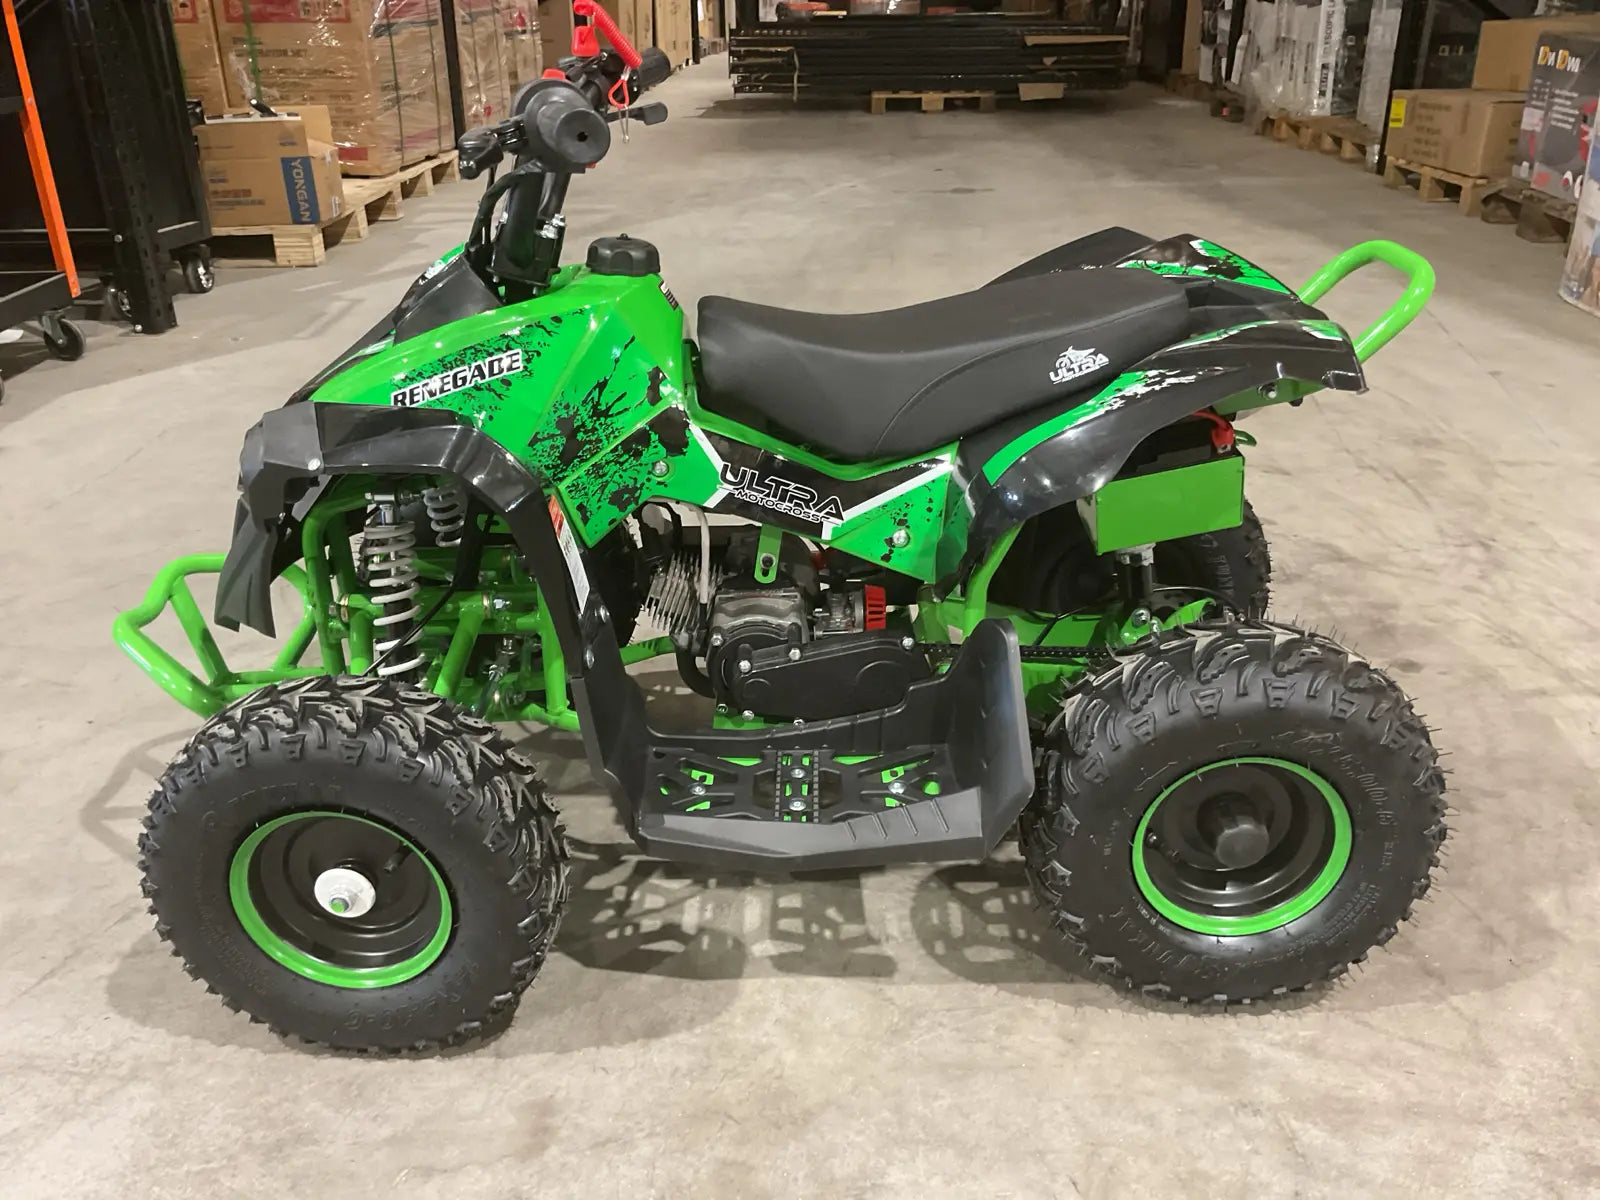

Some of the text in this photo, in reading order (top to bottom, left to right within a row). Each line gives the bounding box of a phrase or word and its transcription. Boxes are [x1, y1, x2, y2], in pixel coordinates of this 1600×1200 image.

[291, 158, 312, 222] YONGAN
[392, 350, 521, 406] RENEGADE
[1049, 353, 1110, 381] ULTRA
[720, 461, 844, 521] ULTRA
[735, 488, 821, 523] MOTOCROSS
